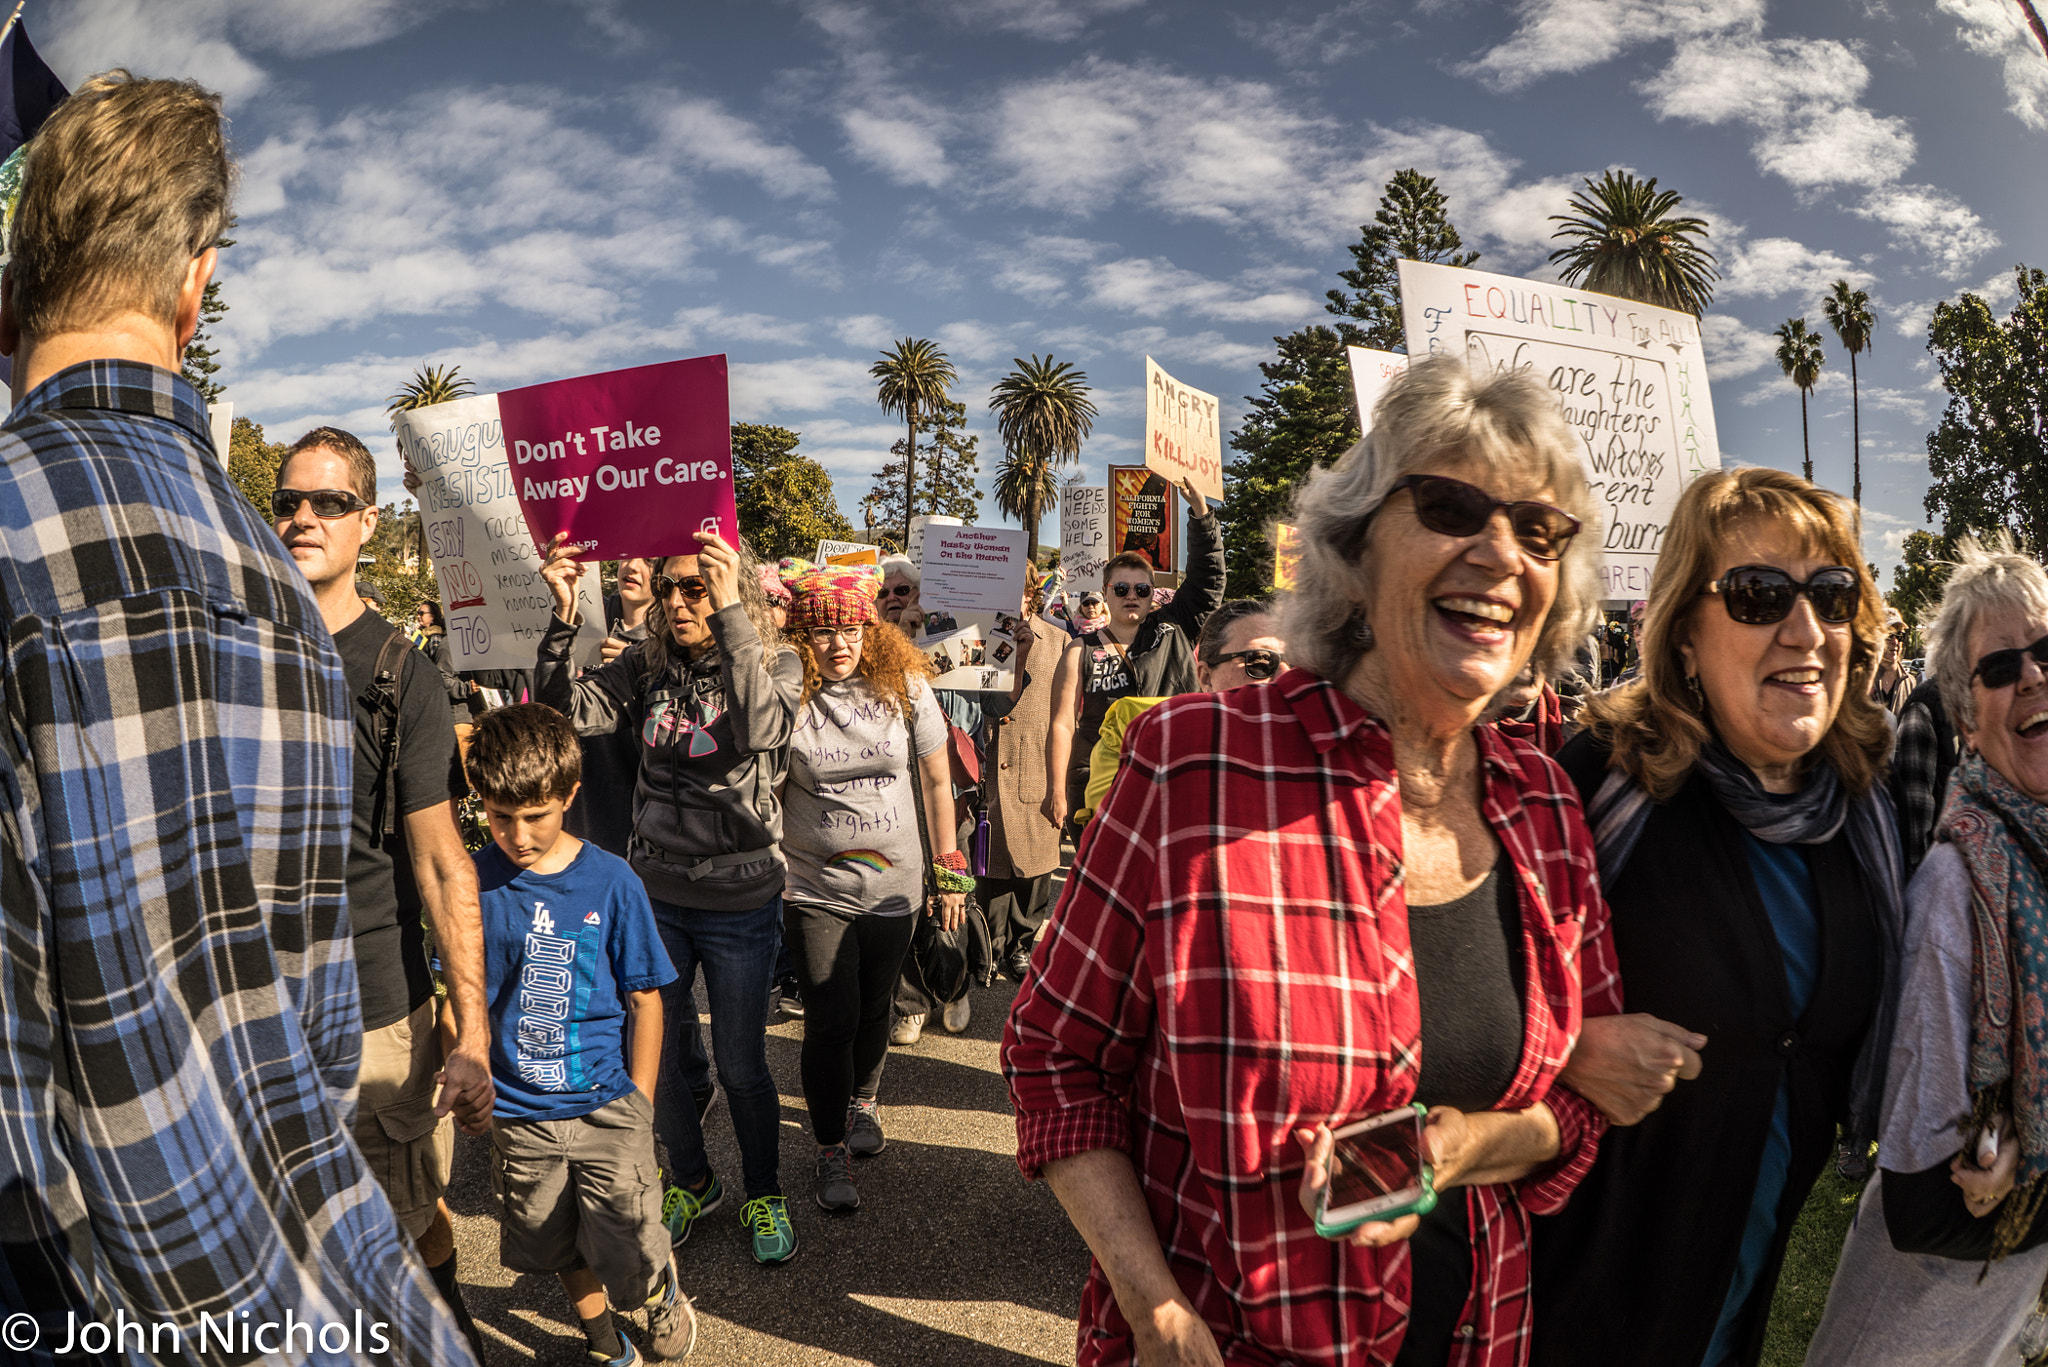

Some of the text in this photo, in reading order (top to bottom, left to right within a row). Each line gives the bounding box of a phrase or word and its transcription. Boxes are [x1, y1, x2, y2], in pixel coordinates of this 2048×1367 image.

[1464, 283, 1618, 338] EQUALITY
[1548, 366, 1597, 396] are
[1610, 356, 1655, 409] the
[1153, 371, 1215, 419] ANGRY
[514, 420, 662, 465] Don't Take
[523, 458, 727, 503] Away Our Care.
[1064, 487, 1105, 502] HOPE
[1119, 494, 1167, 503] CALIFORNIA
[1064, 502, 1107, 518] NEEDS
[1128, 502, 1158, 510] FIGHTS
[1135, 510, 1151, 518] FOR
[1063, 518, 1099, 532] SOME
[1125, 518, 1161, 526] WOMEN'S
[1128, 525, 1158, 534] RIGHTS
[428, 517, 465, 559] SAY
[955, 531, 997, 541] Another
[1065, 532, 1103, 548] HELP
[940, 540, 1011, 553] Nasty Woman
[940, 550, 1009, 563] On the March
[1066, 557, 1108, 583] STRONG
[442, 561, 483, 602] NO
[451, 615, 492, 655] TO
[861, 740, 894, 760] are
[820, 806, 900, 840] Rights!
[532, 902, 555, 935] LA
